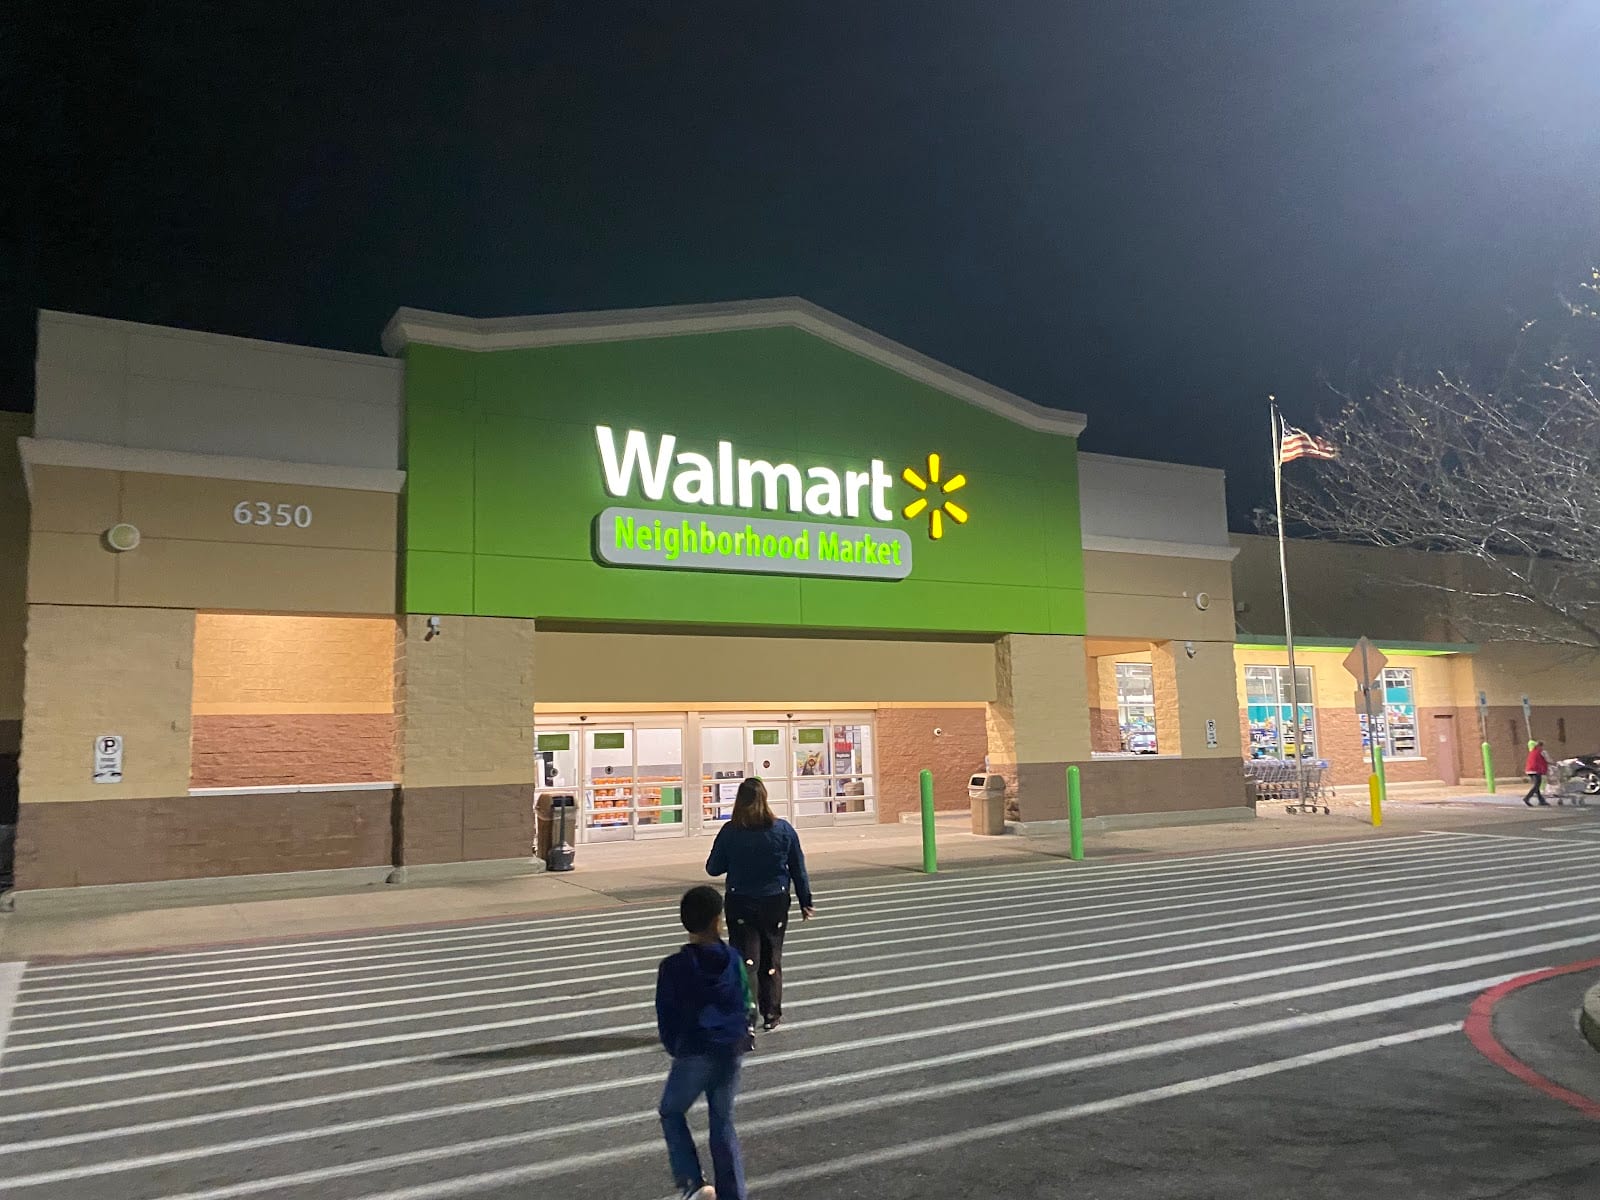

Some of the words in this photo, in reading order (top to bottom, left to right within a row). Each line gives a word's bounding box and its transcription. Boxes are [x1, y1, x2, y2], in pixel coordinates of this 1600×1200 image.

[595, 425, 893, 522] Walmart
[233, 501, 313, 528] 6350
[614, 516, 809, 561] Neighborhood
[818, 531, 902, 566] Market
